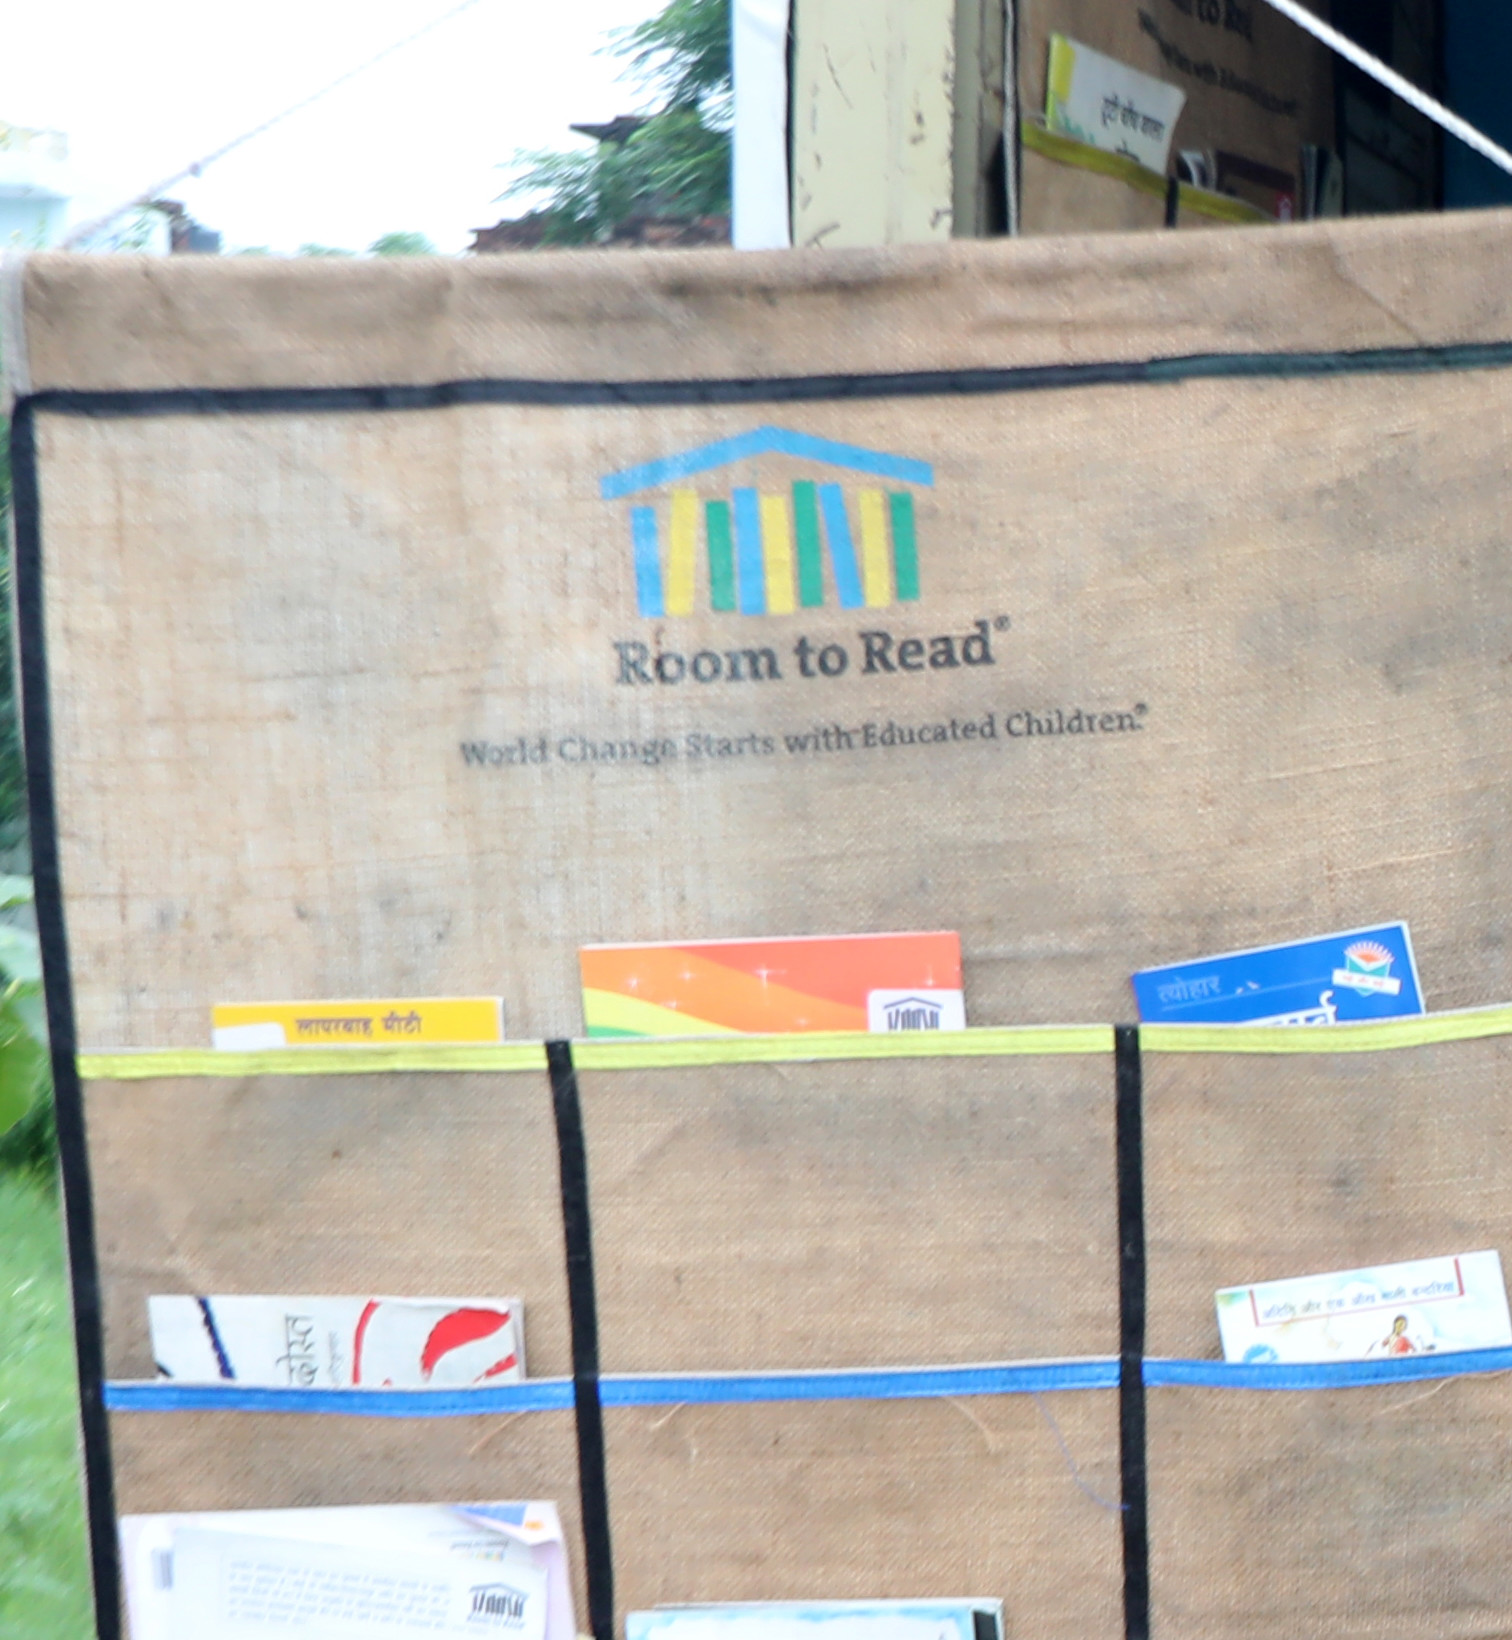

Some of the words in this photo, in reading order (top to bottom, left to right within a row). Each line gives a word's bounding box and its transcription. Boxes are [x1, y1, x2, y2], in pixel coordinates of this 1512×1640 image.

[614, 639, 780, 685] Room
[800, 636, 847, 679] to
[461, 740, 549, 768] World
[558, 734, 678, 767] Change
[687, 728, 774, 758] Starts
[785, 723, 854, 754] with
[864, 713, 996, 749] Educated
